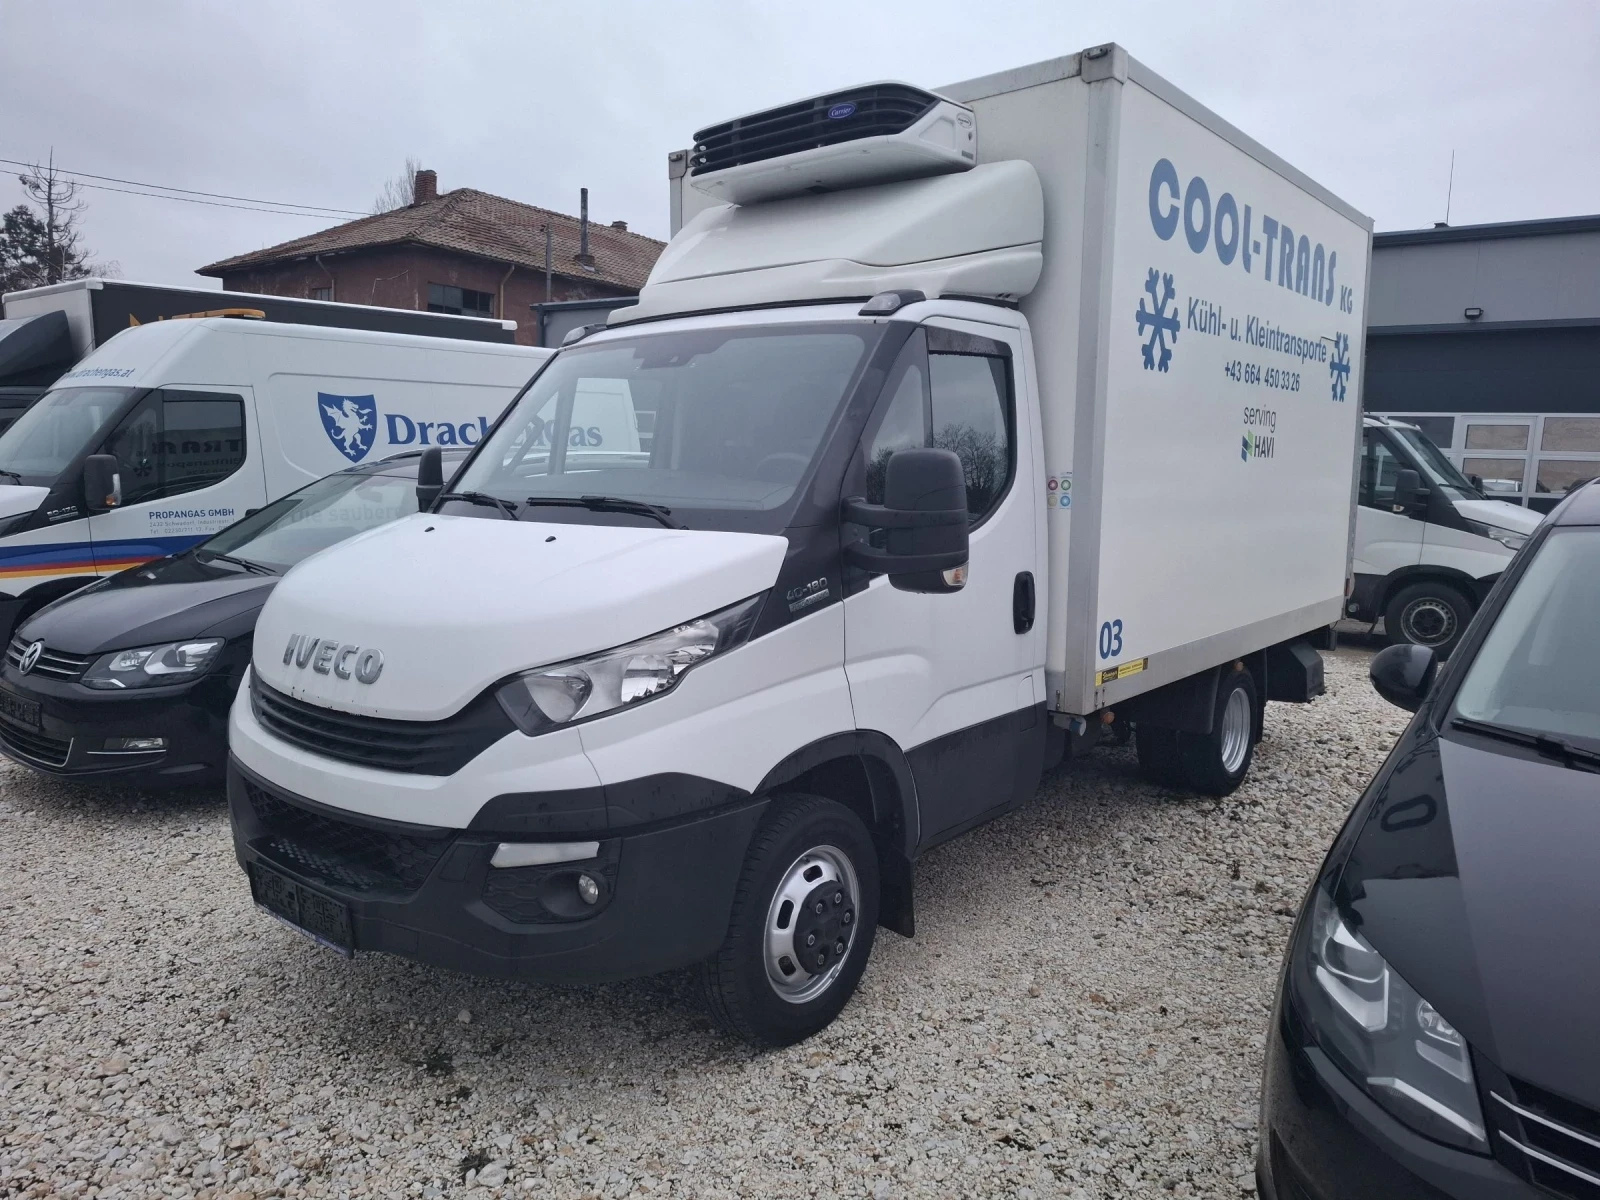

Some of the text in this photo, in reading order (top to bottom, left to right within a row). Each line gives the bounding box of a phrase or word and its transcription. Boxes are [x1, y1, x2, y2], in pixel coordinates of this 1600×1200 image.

[830, 106, 852, 117] Carrier
[1149, 158, 1354, 315] COOL-TRANS KG
[1187, 296, 1327, 364] Kühl- u. Kleintransporte
[1224, 360, 1242, 382] +43
[1244, 363, 1261, 385] 664
[1243, 404, 1277, 434] serving
[1254, 435, 1275, 459] HAVI
[149, 508, 235, 520] PROPANGAS GMBH
[786, 576, 829, 601] 40-180
[1099, 618, 1123, 660] 03
[282, 633, 385, 685] IVECO
